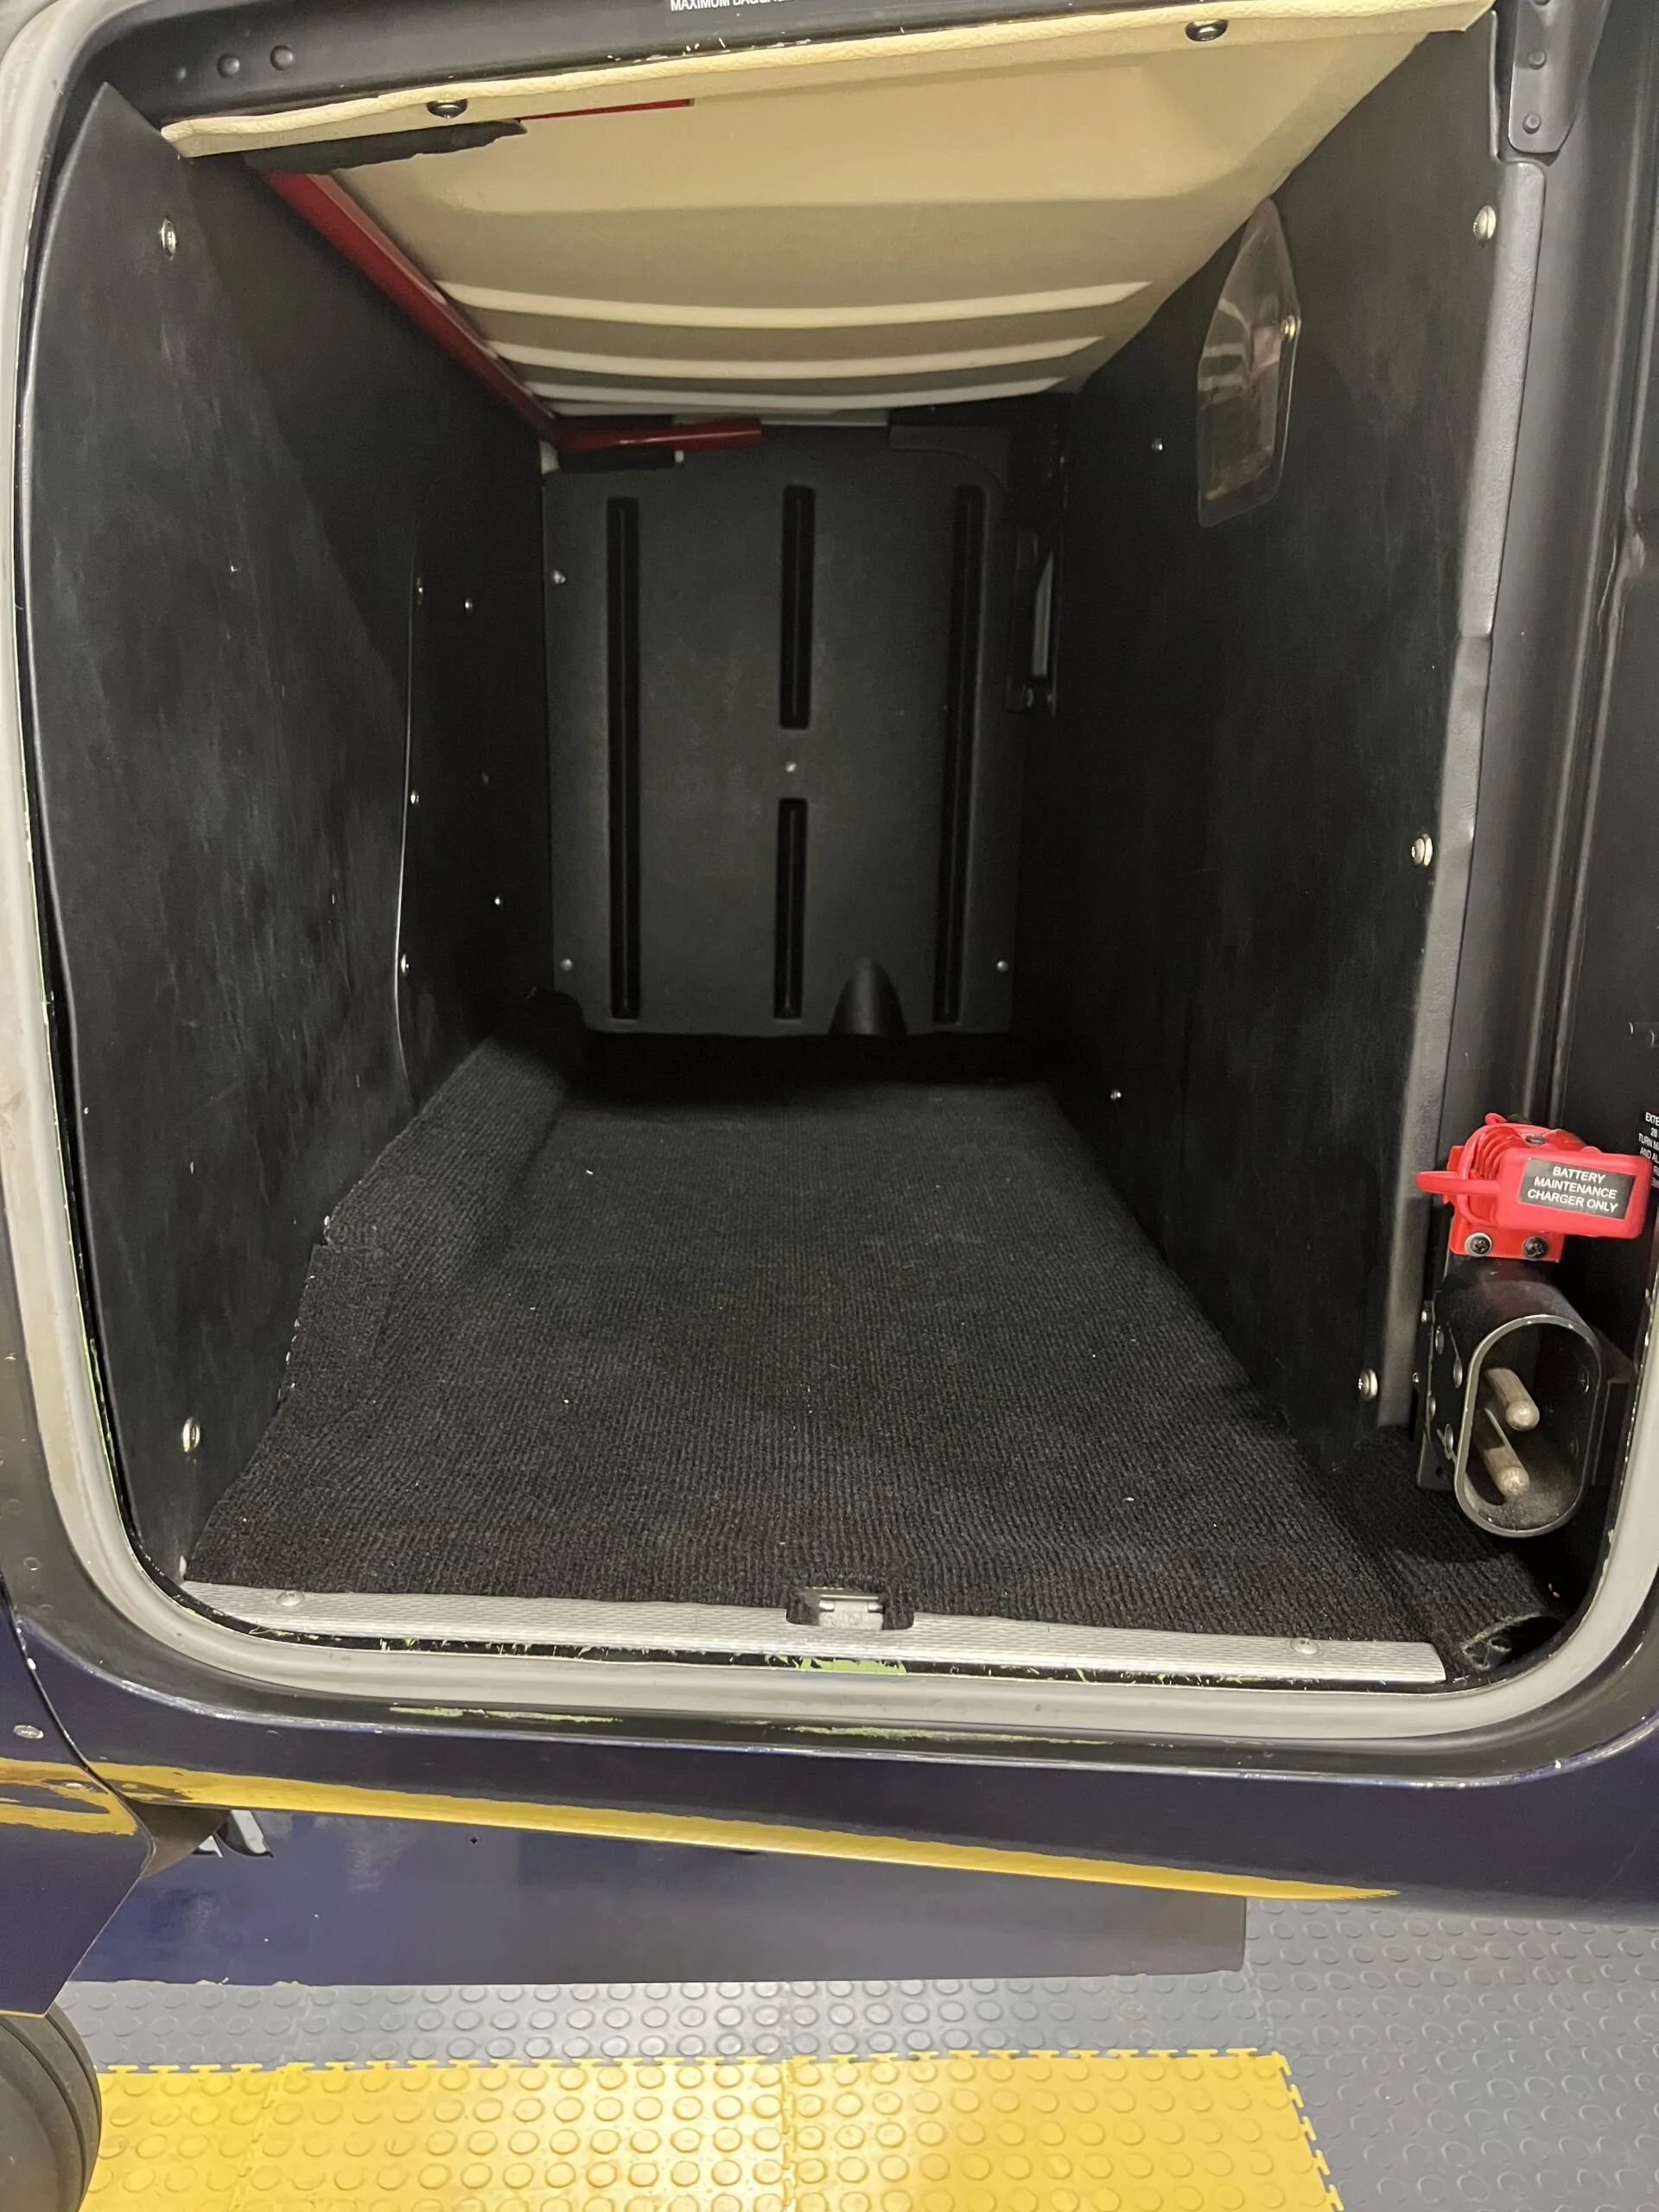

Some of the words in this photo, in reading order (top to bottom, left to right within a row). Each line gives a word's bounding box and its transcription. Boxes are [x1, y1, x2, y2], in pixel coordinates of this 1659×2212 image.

[671, 0, 730, 11] MAXIMUM
[1553, 1166, 1605, 1184] BATTERY
[1534, 1177, 1618, 1199] MAINTENANCE
[1528, 1189, 1585, 1207] CHARGER
[1586, 1199, 1618, 1212] ONLY
